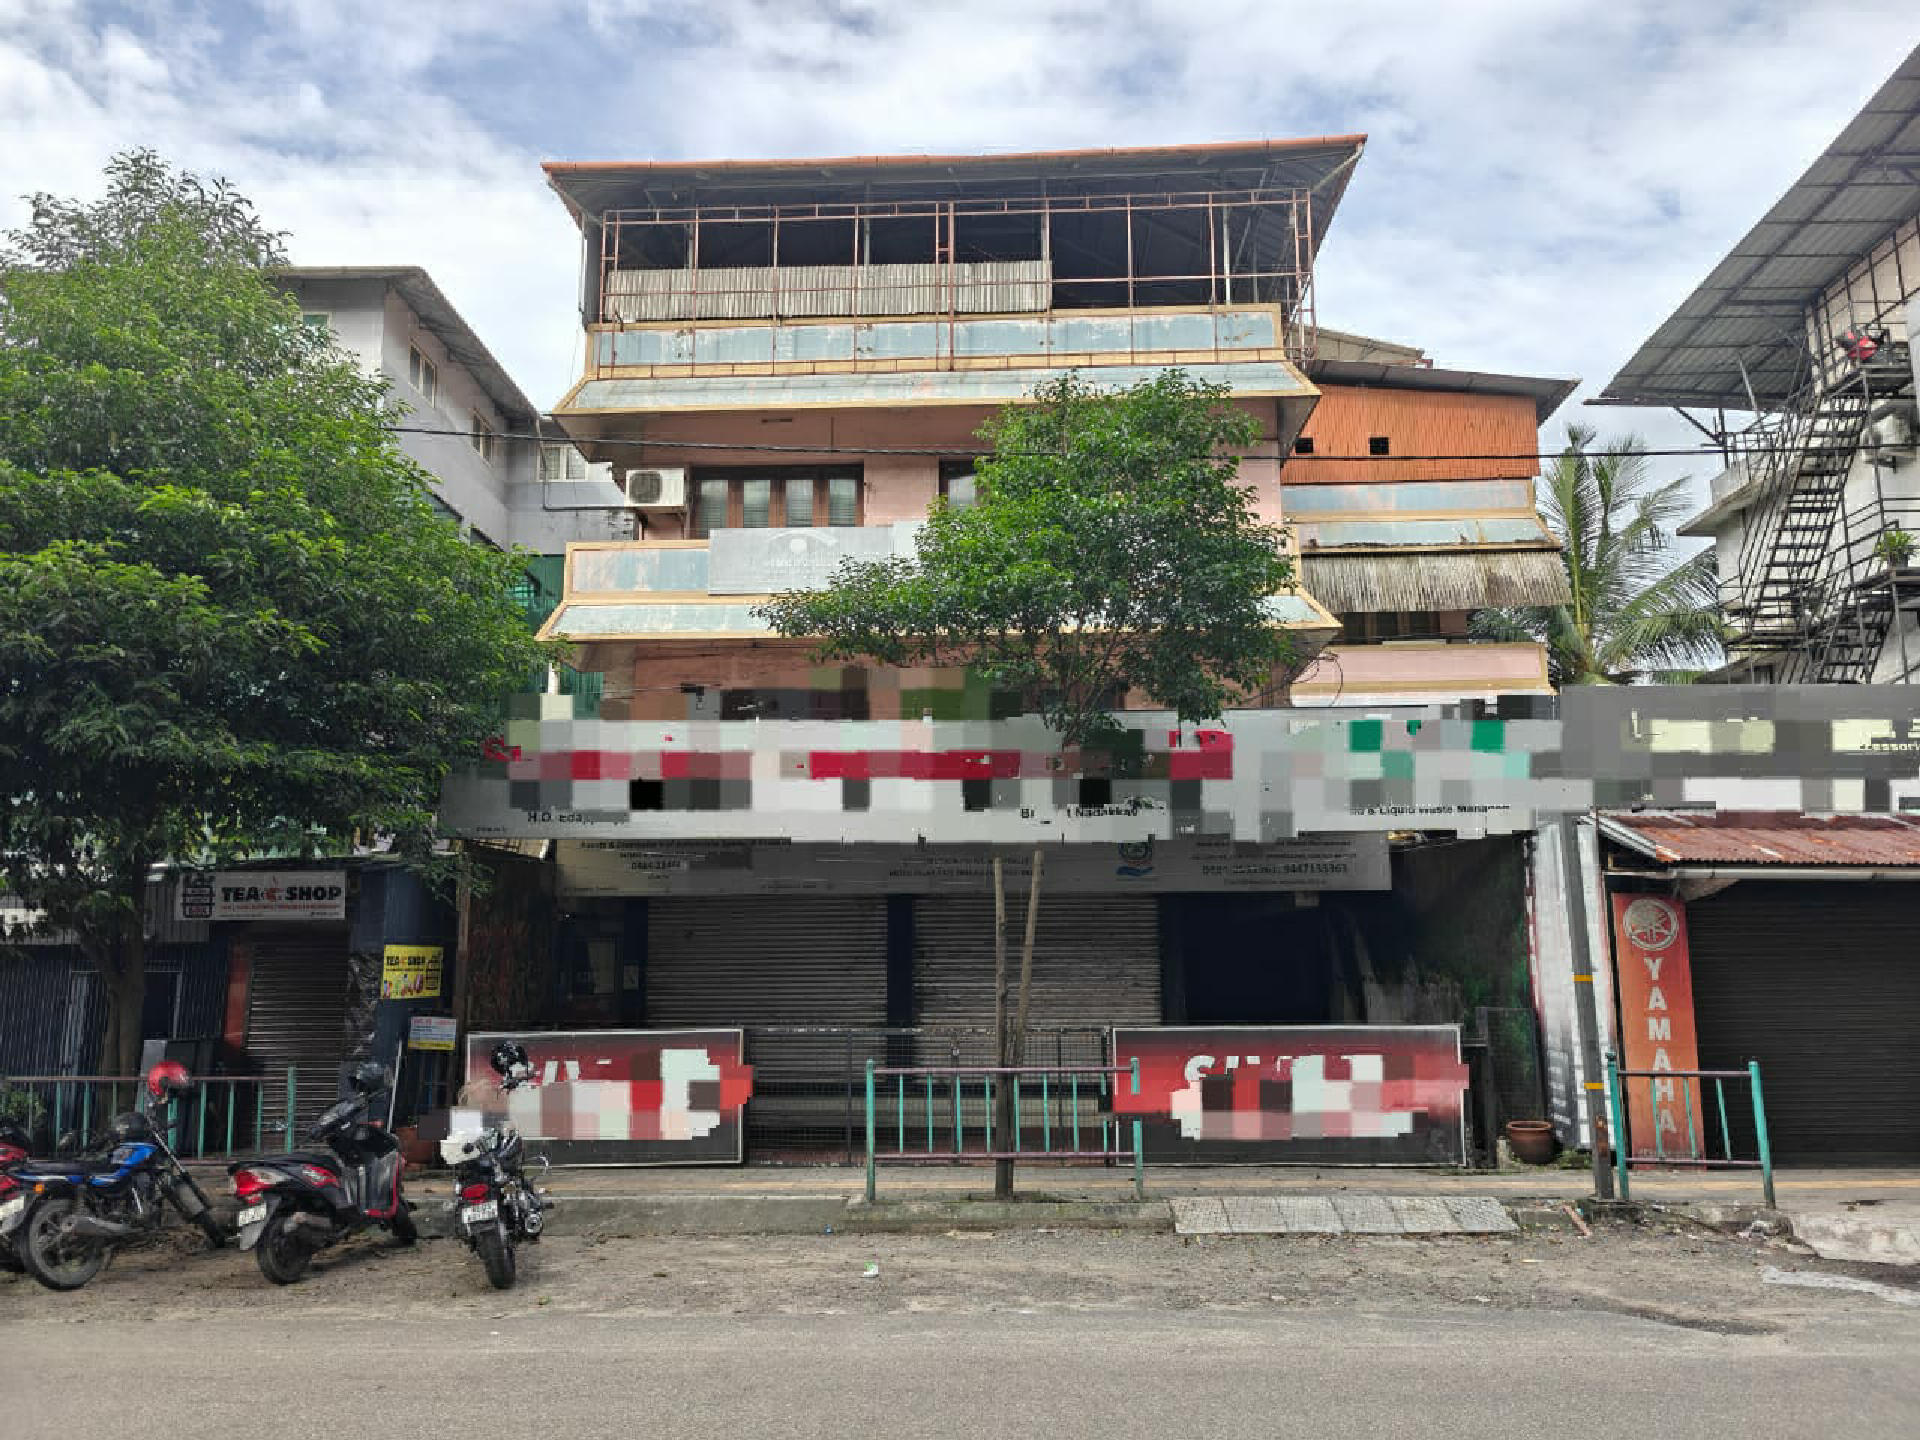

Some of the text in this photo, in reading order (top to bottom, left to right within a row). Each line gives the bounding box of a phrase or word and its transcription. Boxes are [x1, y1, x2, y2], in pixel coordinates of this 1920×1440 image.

[221, 887, 263, 901] TEA
[285, 886, 342, 901] SHOP
[1643, 956, 1677, 1134] YAMAHA
